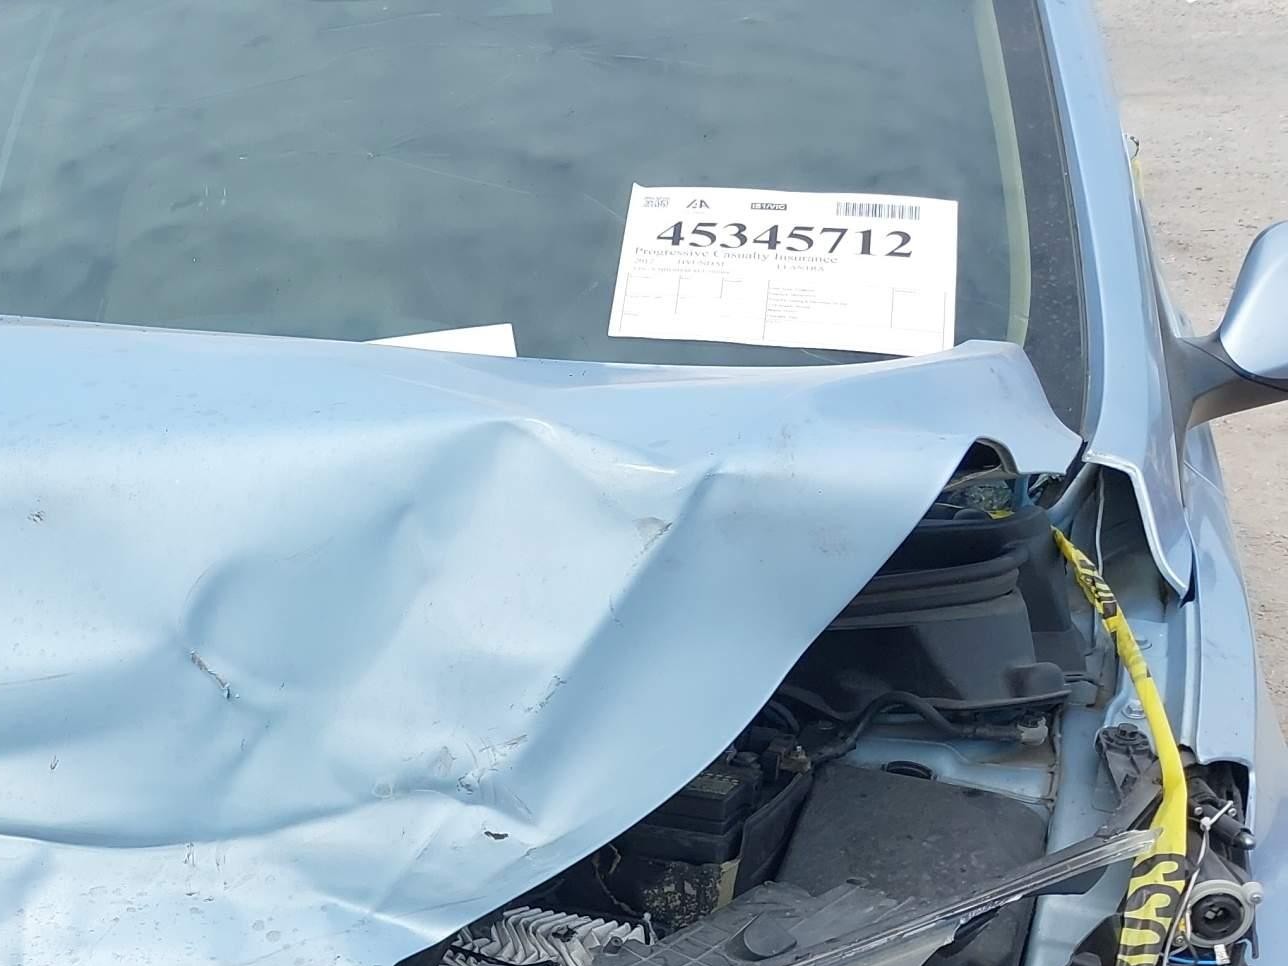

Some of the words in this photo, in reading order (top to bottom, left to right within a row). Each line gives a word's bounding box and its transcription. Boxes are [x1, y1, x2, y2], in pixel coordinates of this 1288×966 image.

[656, 221, 913, 258] 45345712
[635, 247, 710, 258] Progressive
[713, 249, 770, 262] Casualty
[775, 252, 839, 264] Insurance
